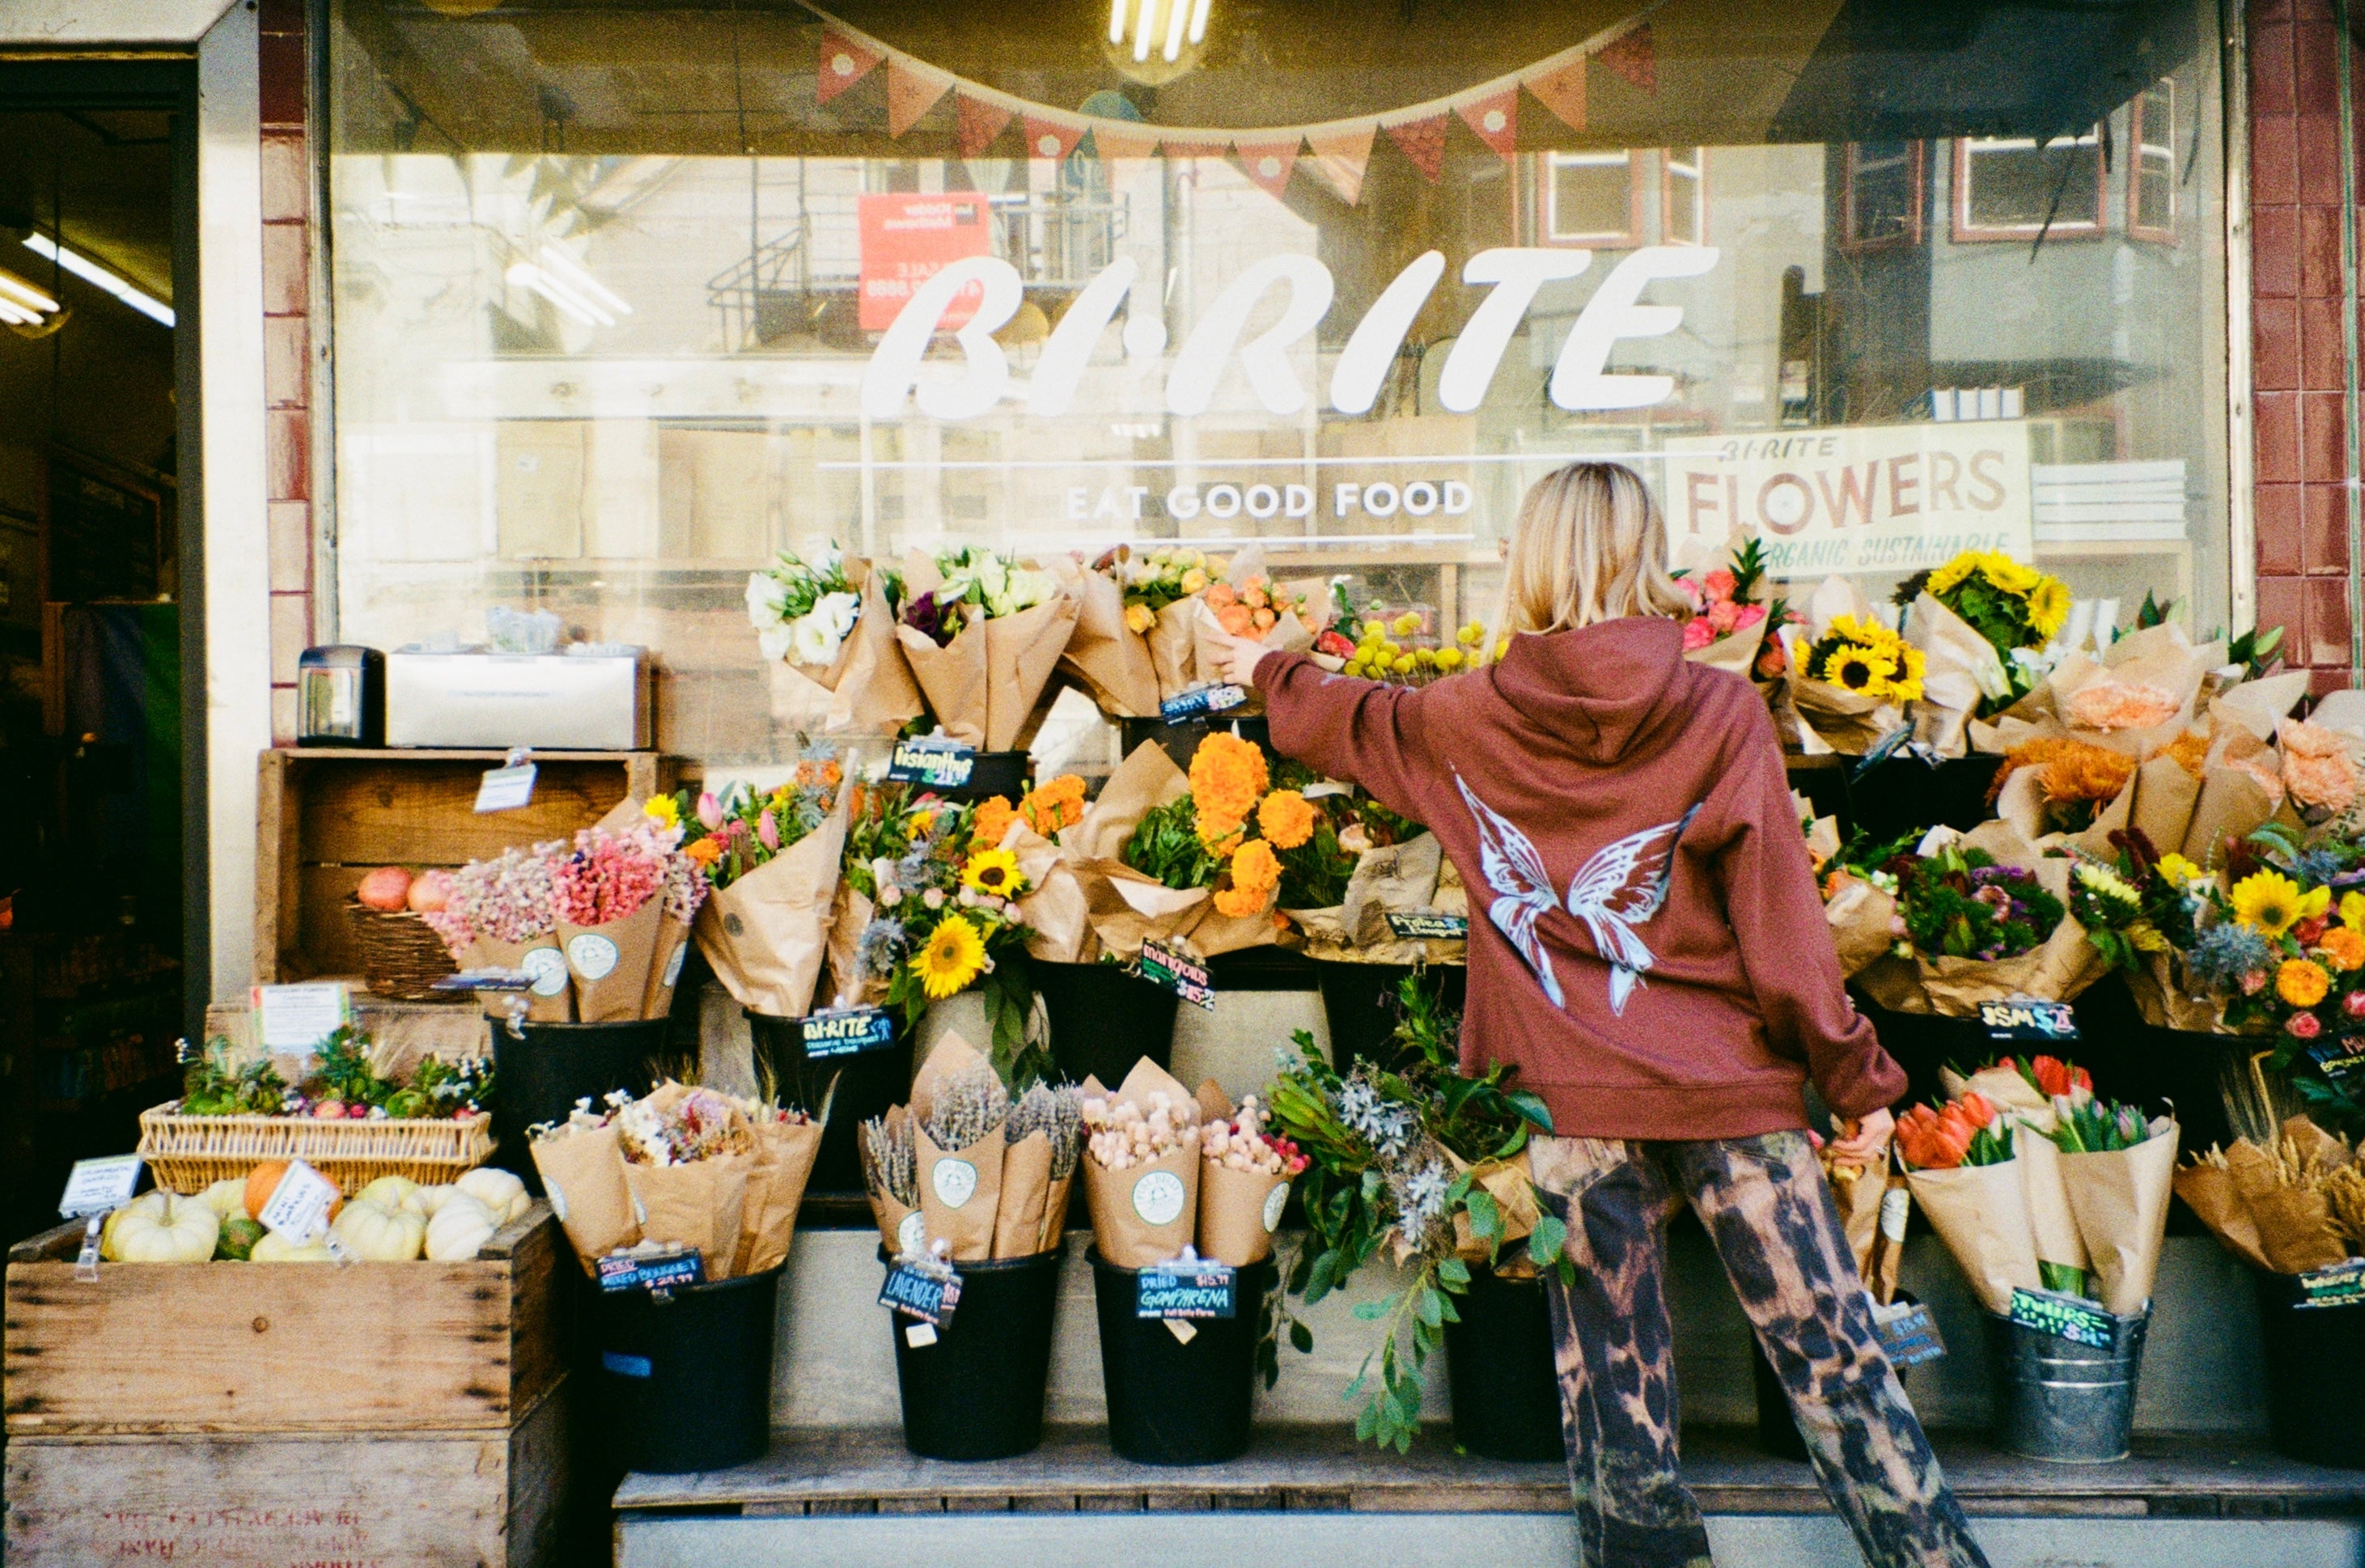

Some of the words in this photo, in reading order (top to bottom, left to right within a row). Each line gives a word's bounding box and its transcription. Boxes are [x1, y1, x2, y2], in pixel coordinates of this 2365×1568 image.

[1067, 485, 1149, 520] EAT
[1167, 484, 1314, 519] GOOD
[1336, 481, 1473, 518] FOOD
[1685, 449, 2007, 536] FLOWERS
[885, 1271, 943, 1313] LAVENDER
[1140, 1288, 1228, 1309] GOMPHRENA
[1141, 1275, 1177, 1289] DRIED
